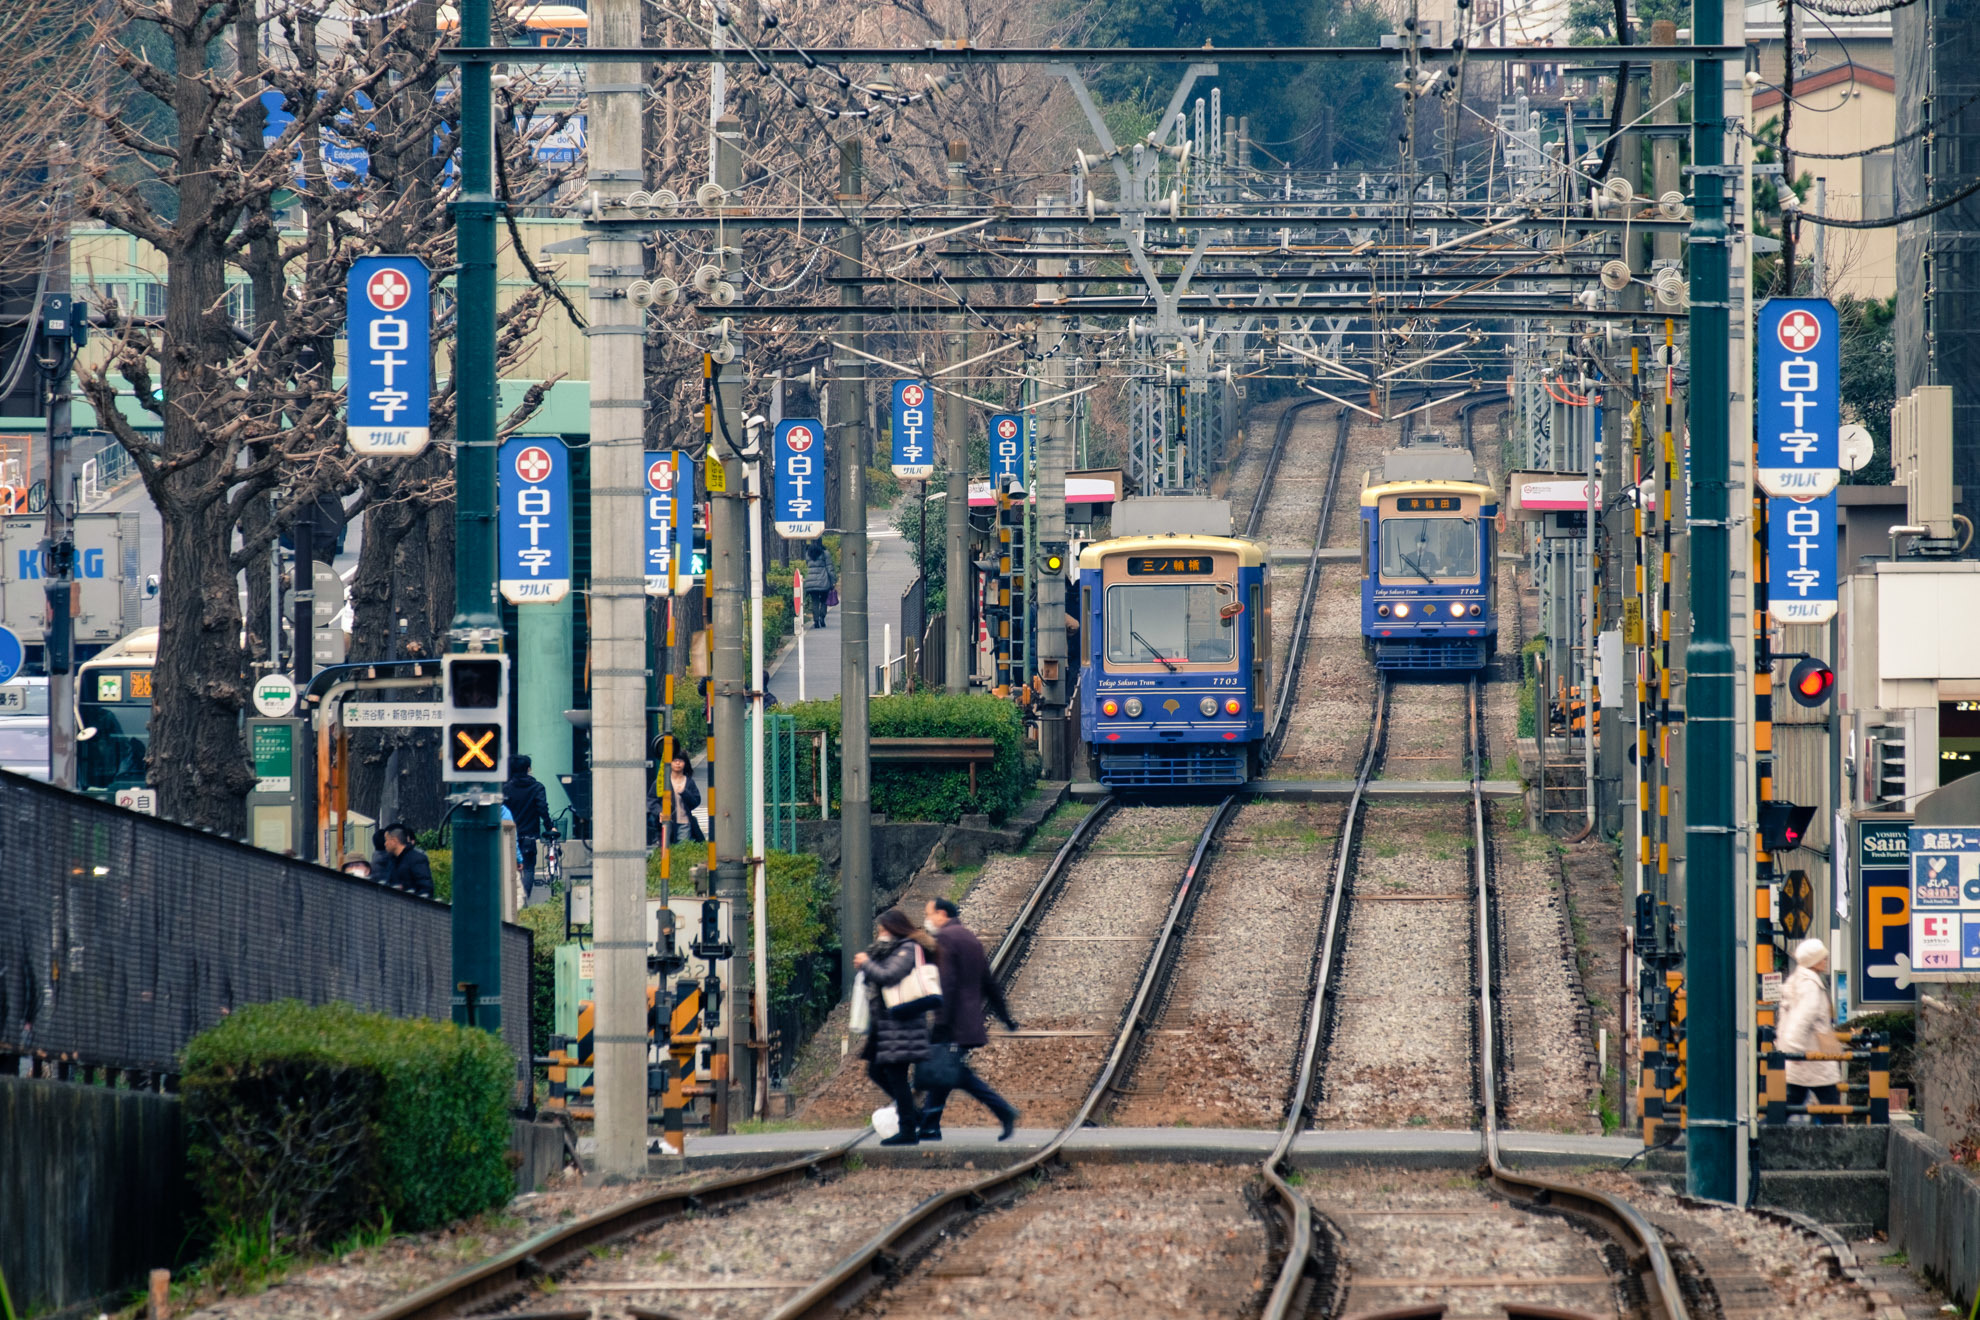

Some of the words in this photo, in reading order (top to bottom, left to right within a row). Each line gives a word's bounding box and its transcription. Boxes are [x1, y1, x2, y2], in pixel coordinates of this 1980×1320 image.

[369, 314, 409, 422] 白十字
[1779, 356, 1819, 464] 白十字
[369, 431, 410, 446] サルバ
[903, 408, 923, 463] 白十字
[999, 440, 1017, 477] 白十
[787, 454, 812, 519] 白十字
[1779, 472, 1821, 488] サルバ
[1411, 499, 1450, 509] 早稲田
[518, 486, 552, 576] 白十字
[649, 494, 672, 572] 白十字
[788, 523, 813, 533] サルバ
[1787, 506, 1820, 596] 白十字
[19, 548, 104, 579] KG
[1143, 560, 1200, 572] 三ノ輪橋
[519, 583, 553, 596] サルバ
[649, 579, 668, 589] サル
[1787, 604, 1822, 617] サルバ
[1098, 680, 1116, 689] Tokyo
[1118, 679, 1138, 687] Sakura
[1213, 677, 1238, 686] 7703
[1863, 836, 1910, 852] Sain
[1923, 832, 1980, 850] 食品スー
[1927, 878, 1949, 888] よしや
[1917, 886, 1959, 899] SainE
[1868, 886, 1910, 950] P
[1924, 953, 1949, 965] くすり
